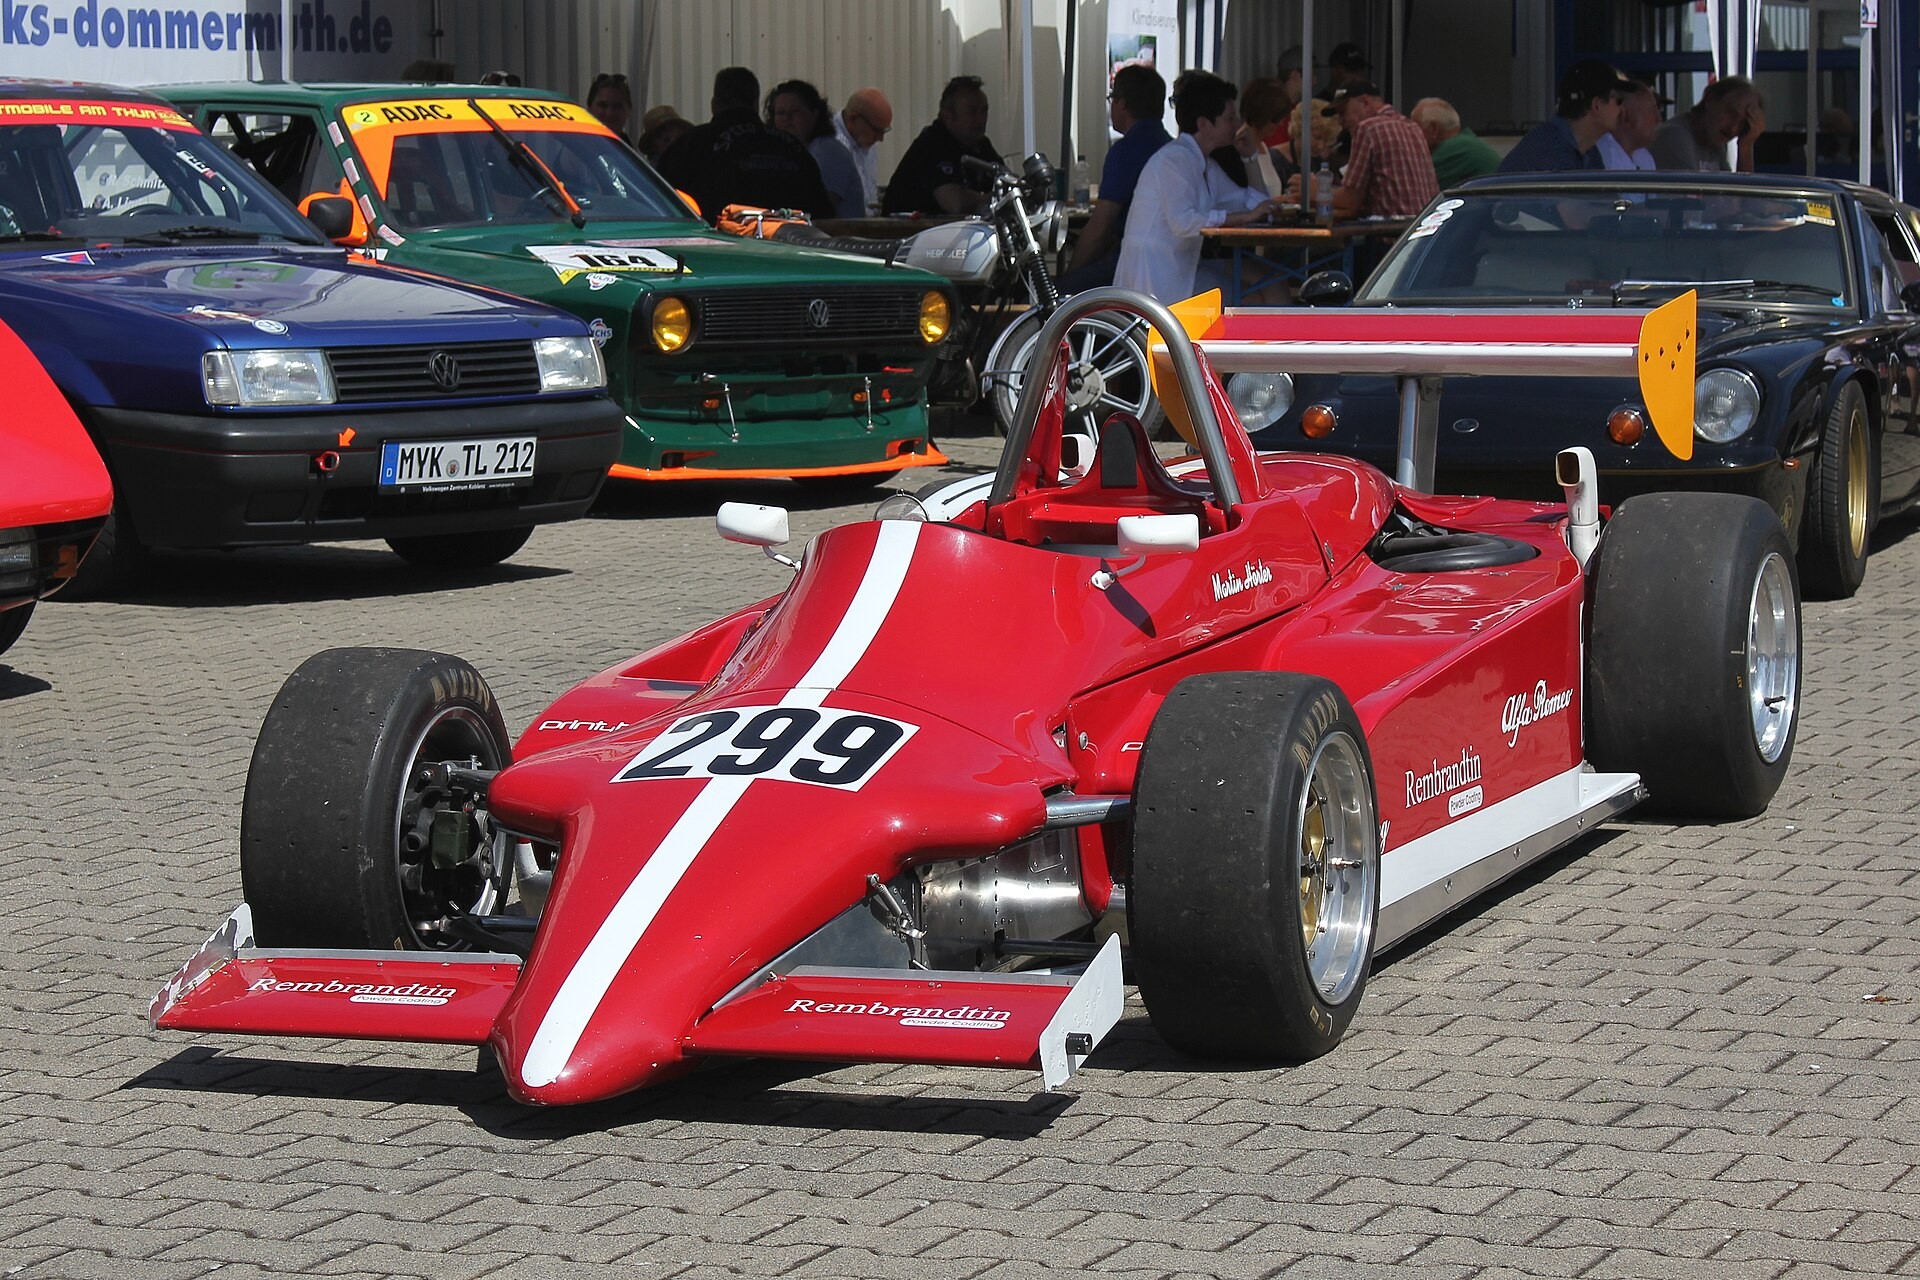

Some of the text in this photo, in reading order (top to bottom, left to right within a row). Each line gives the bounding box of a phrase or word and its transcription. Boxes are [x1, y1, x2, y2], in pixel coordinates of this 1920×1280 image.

[79, 105, 107, 116] AM
[360, 111, 373, 123] 2
[381, 104, 453, 123] ADAC
[508, 103, 575, 121] ADAC
[569, 253, 657, 267] 164
[398, 441, 534, 480] MYK TL 212
[386, 467, 393, 478] D
[1211, 568, 1243, 602] Martin
[1501, 679, 1574, 748] Alfa Romeo
[1294, 691, 1339, 776] AVON
[619, 707, 904, 785] 299
[1405, 745, 1481, 809] Rembrandtin
[1450, 790, 1481, 812] Powder Coating
[245, 978, 457, 998] Rembrandtin
[398, 996, 442, 1004] Coating
[783, 999, 1012, 1021] Rembrandtin
[906, 1018, 999, 1029] Powder Coating
